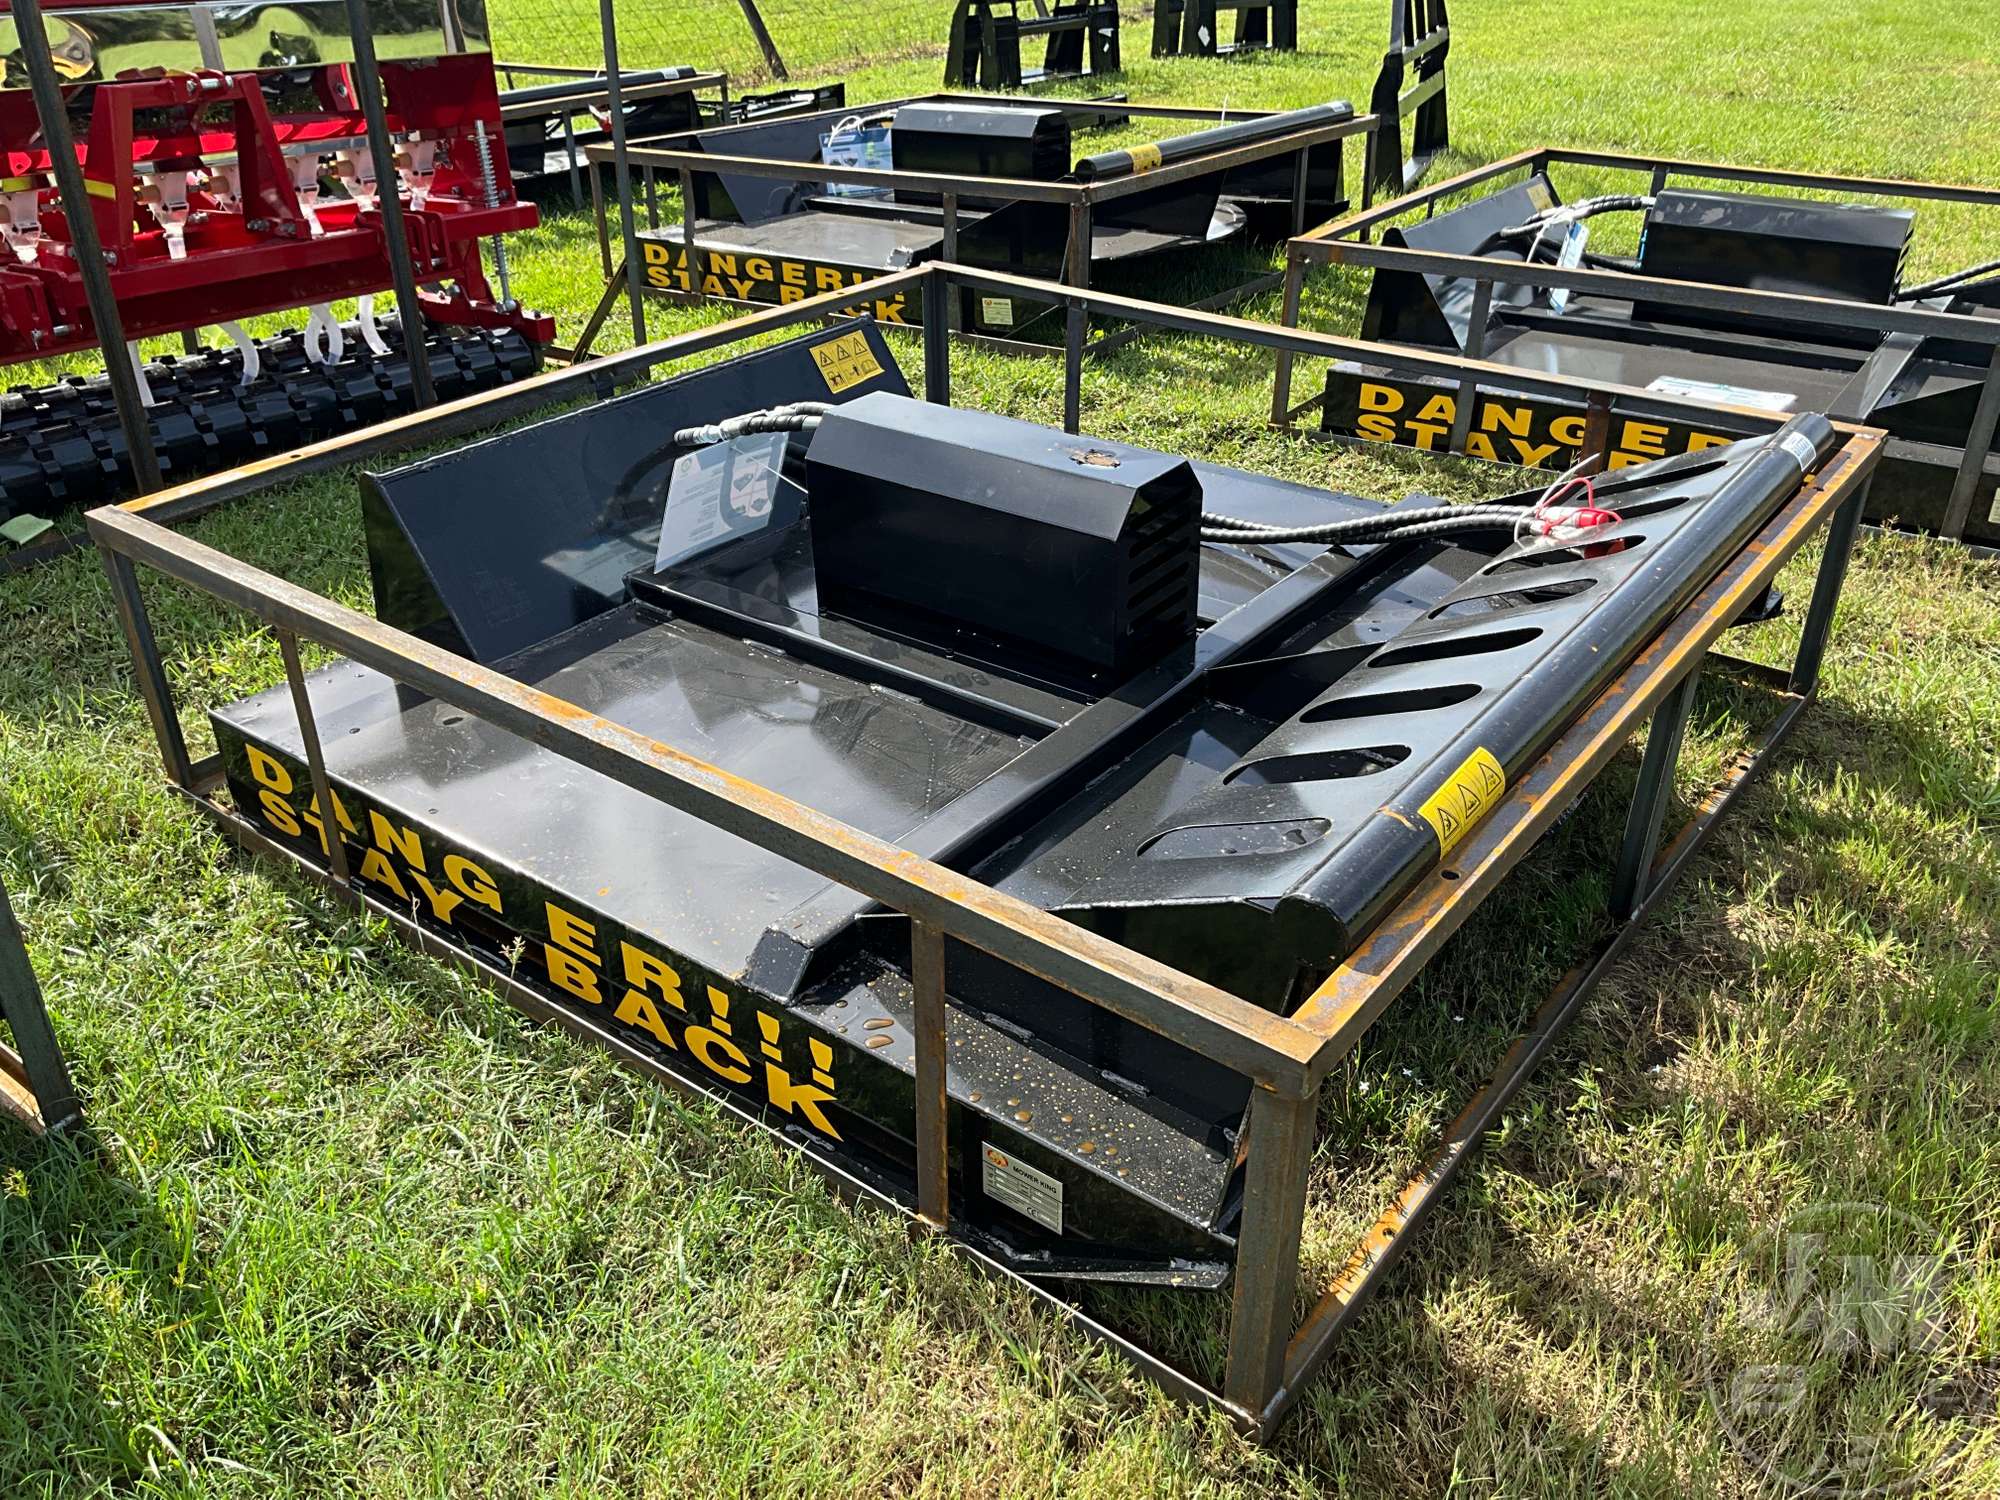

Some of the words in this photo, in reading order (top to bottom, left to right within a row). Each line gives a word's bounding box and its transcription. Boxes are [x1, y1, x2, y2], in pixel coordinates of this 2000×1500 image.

[643, 242, 905, 302] DANGER!
[647, 265, 755, 300] STAY
[779, 284, 905, 324] BK
[1355, 413, 1561, 470] STAY
[258, 789, 465, 925] STAY
[543, 943, 844, 1143] BACK
[1039, 1180, 1057, 1194] KING
